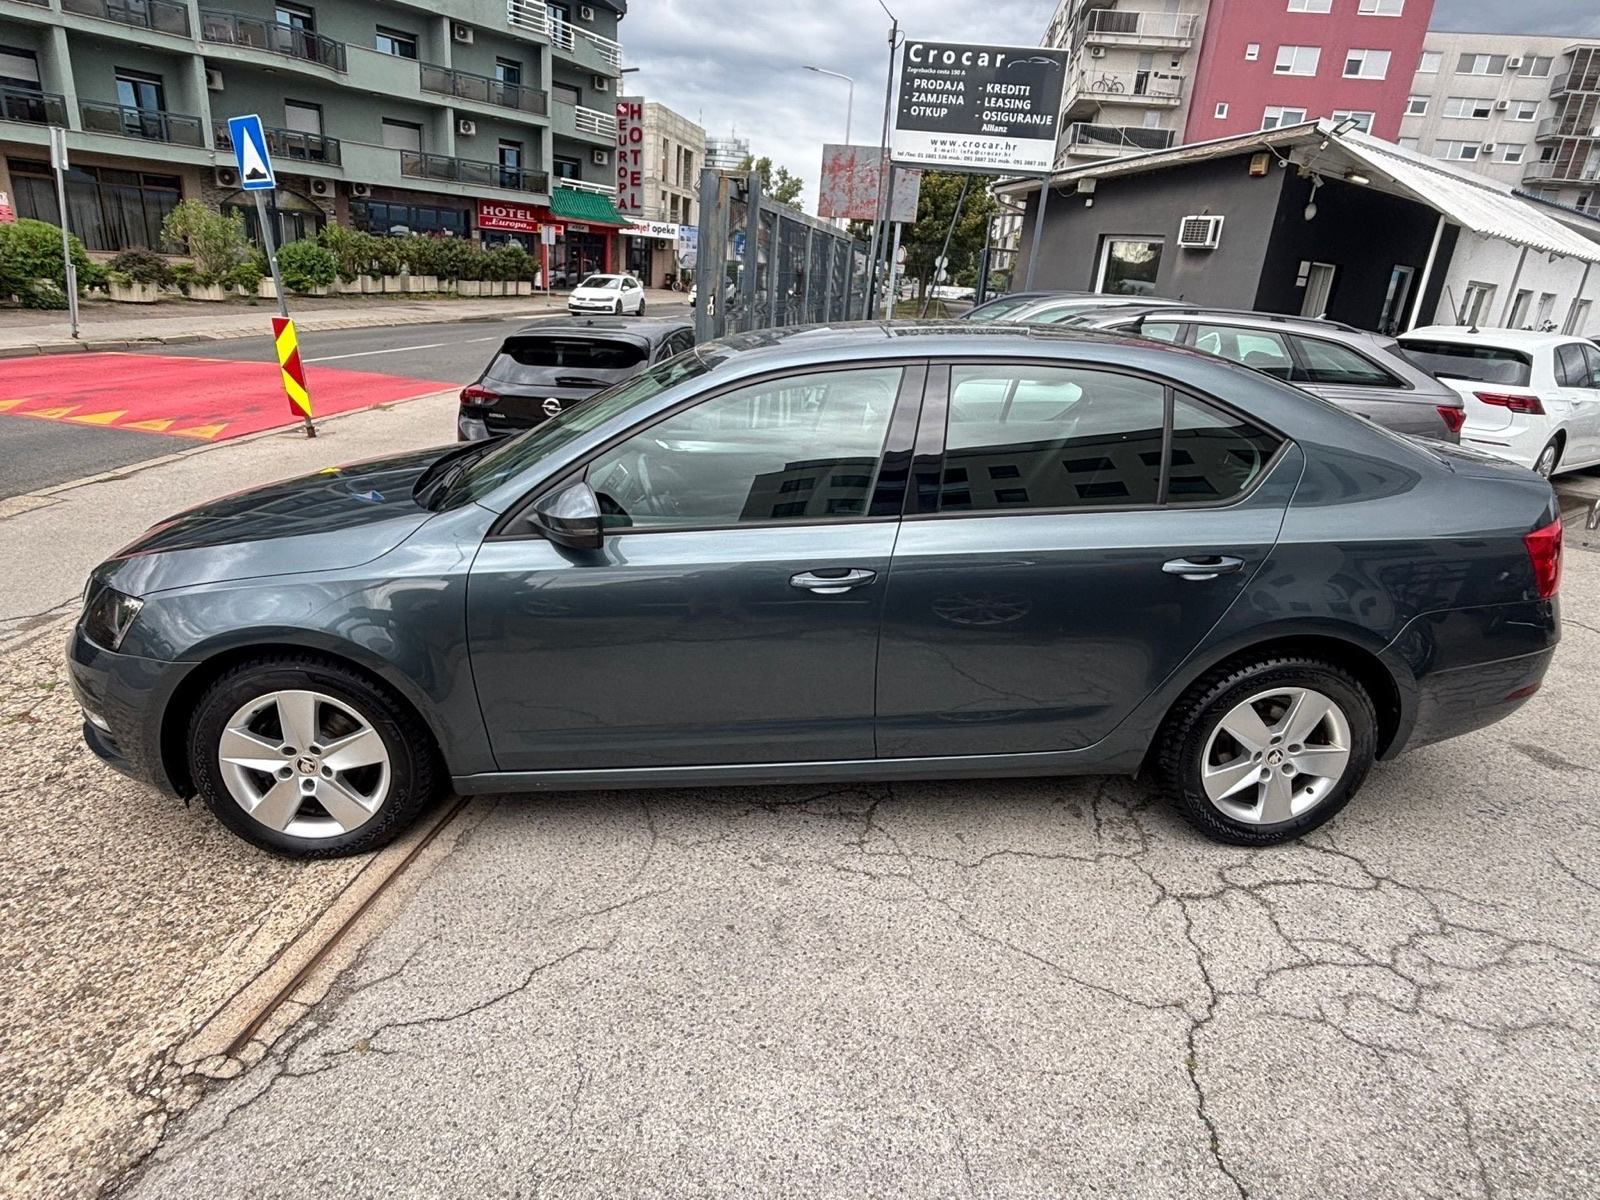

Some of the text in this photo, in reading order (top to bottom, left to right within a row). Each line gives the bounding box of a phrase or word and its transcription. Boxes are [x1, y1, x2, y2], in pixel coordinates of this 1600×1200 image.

[909, 44, 1006, 68] Crocar
[914, 79, 965, 91] PRODAJA
[986, 83, 1030, 96] KREDITI
[912, 93, 964, 105] ZAMJENA
[984, 97, 1031, 110] LEASING
[910, 106, 948, 117] OTKUP
[982, 111, 1053, 125] OSIGURANJE
[982, 124, 1008, 133] Allianz
[930, 138, 1018, 151] www.crocar.hr
[630, 104, 642, 209] HOTEL
[618, 118, 628, 210] EUROPA
[483, 206, 534, 220] HOTEL
[652, 224, 676, 238] opeke
